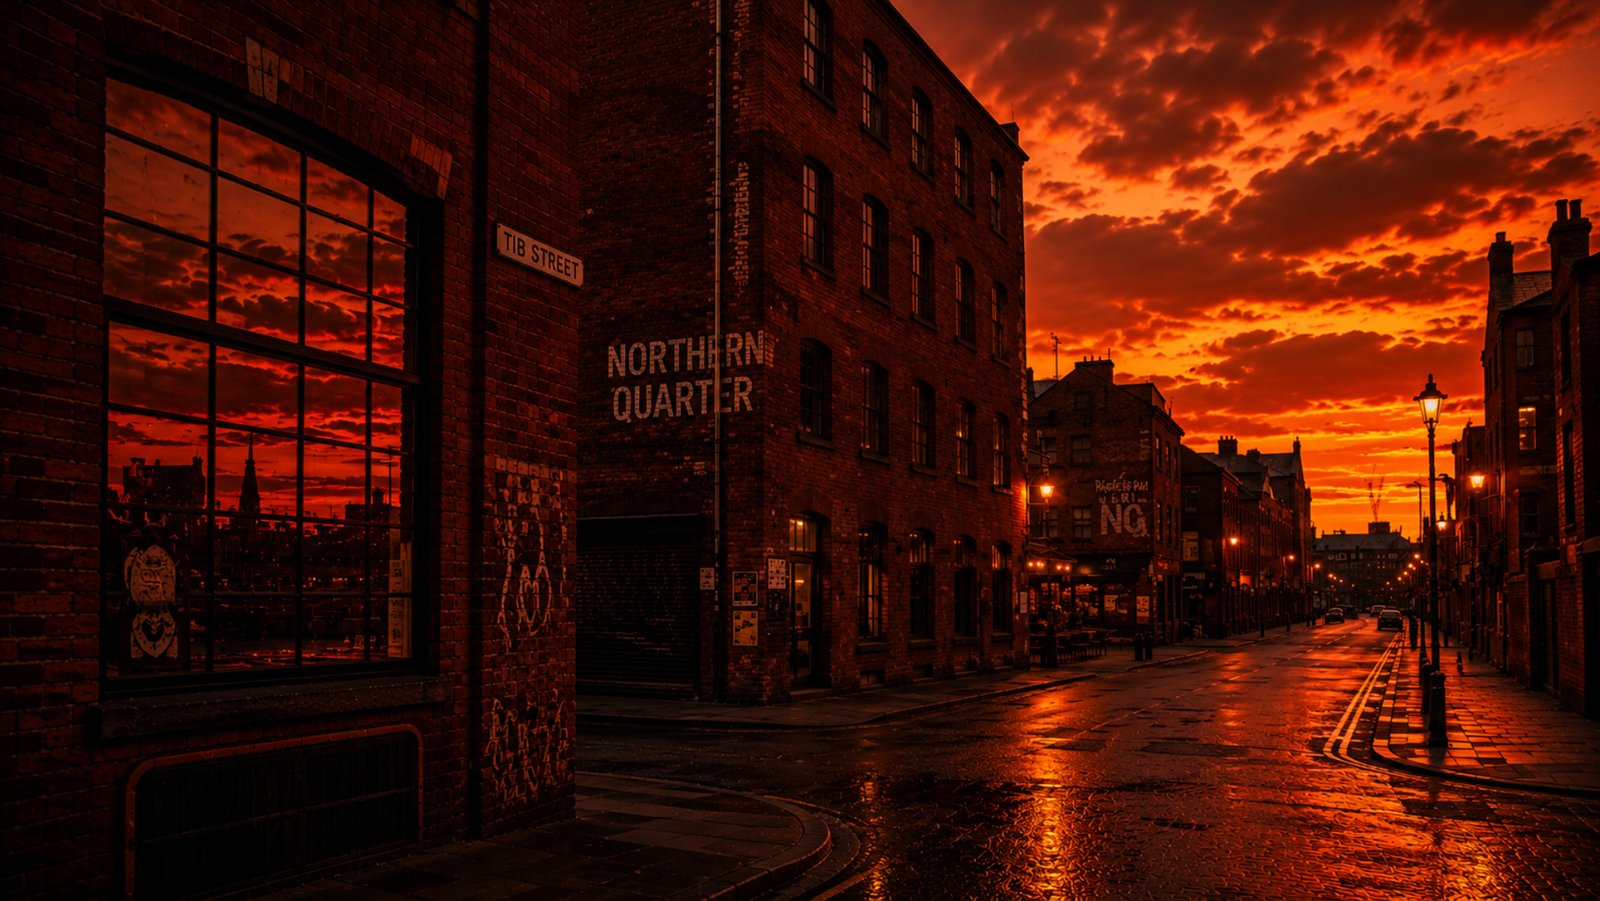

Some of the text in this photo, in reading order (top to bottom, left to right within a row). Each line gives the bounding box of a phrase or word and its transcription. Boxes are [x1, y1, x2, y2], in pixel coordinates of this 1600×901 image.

[504, 231, 579, 279] TIB STREET
[607, 330, 764, 378] NORTHERN
[612, 375, 753, 423] QUARTER
